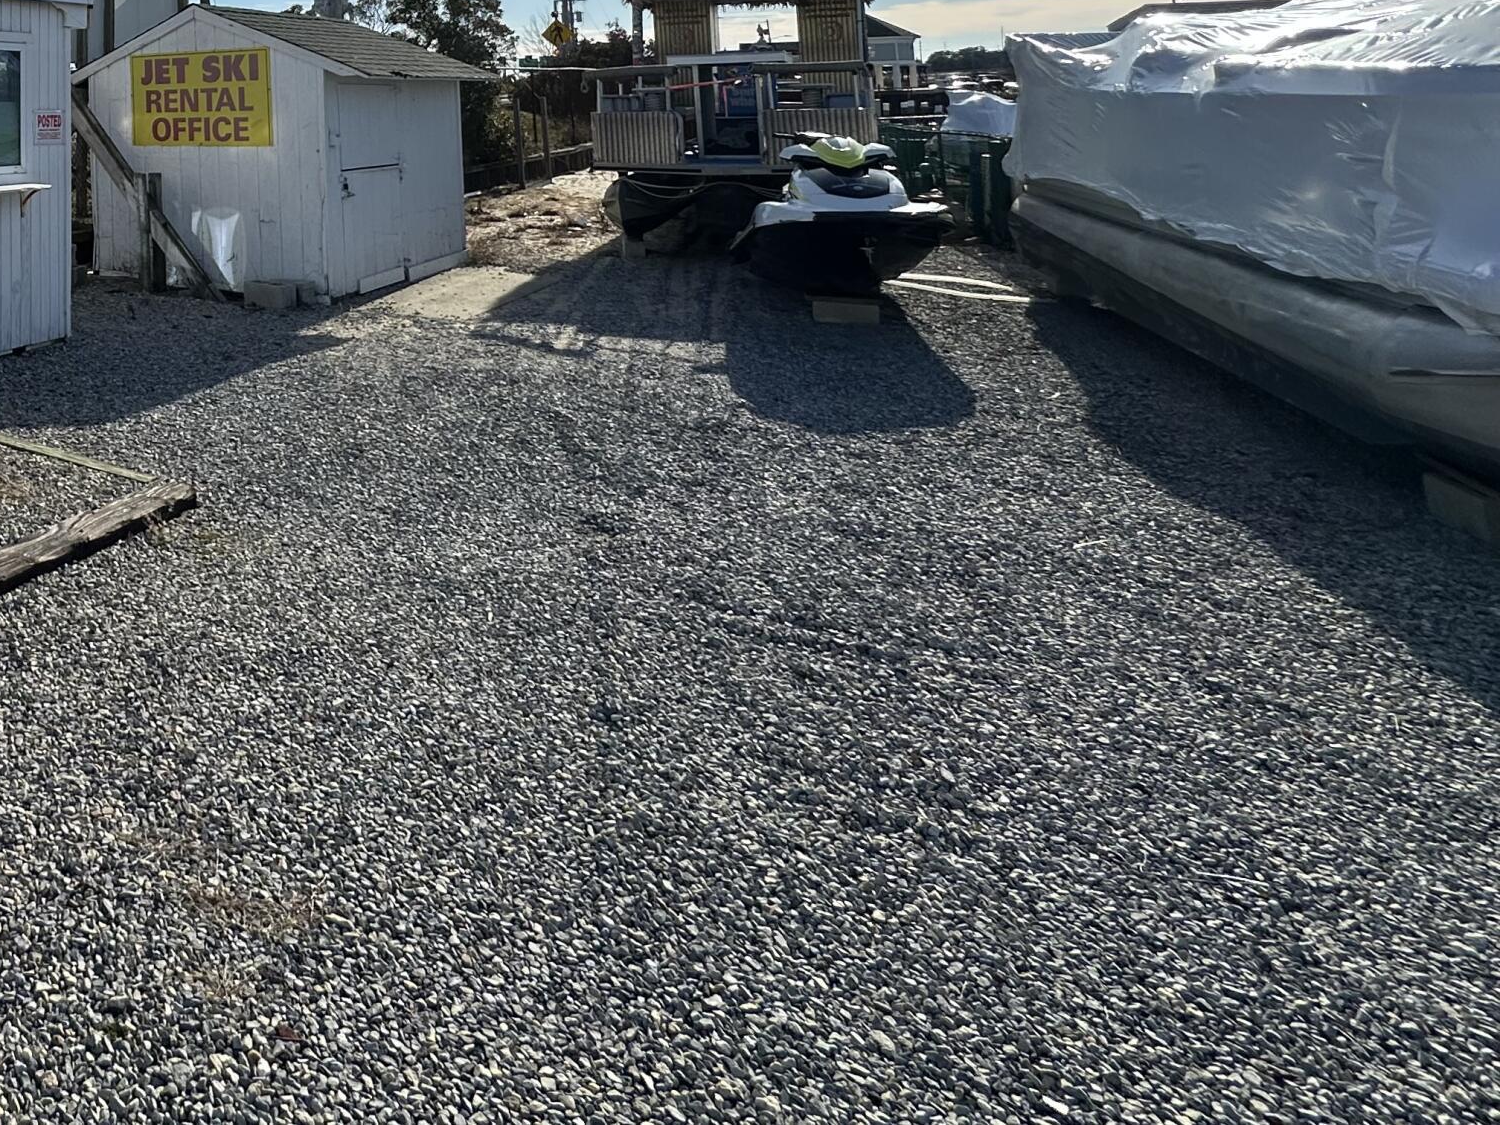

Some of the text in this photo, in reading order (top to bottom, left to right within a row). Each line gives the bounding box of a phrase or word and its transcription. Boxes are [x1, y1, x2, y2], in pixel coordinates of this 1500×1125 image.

[140, 53, 259, 86] JET SKI
[145, 86, 254, 113] RENTAL
[37, 114, 62, 128] POSTED
[152, 116, 250, 142] OFFICE
